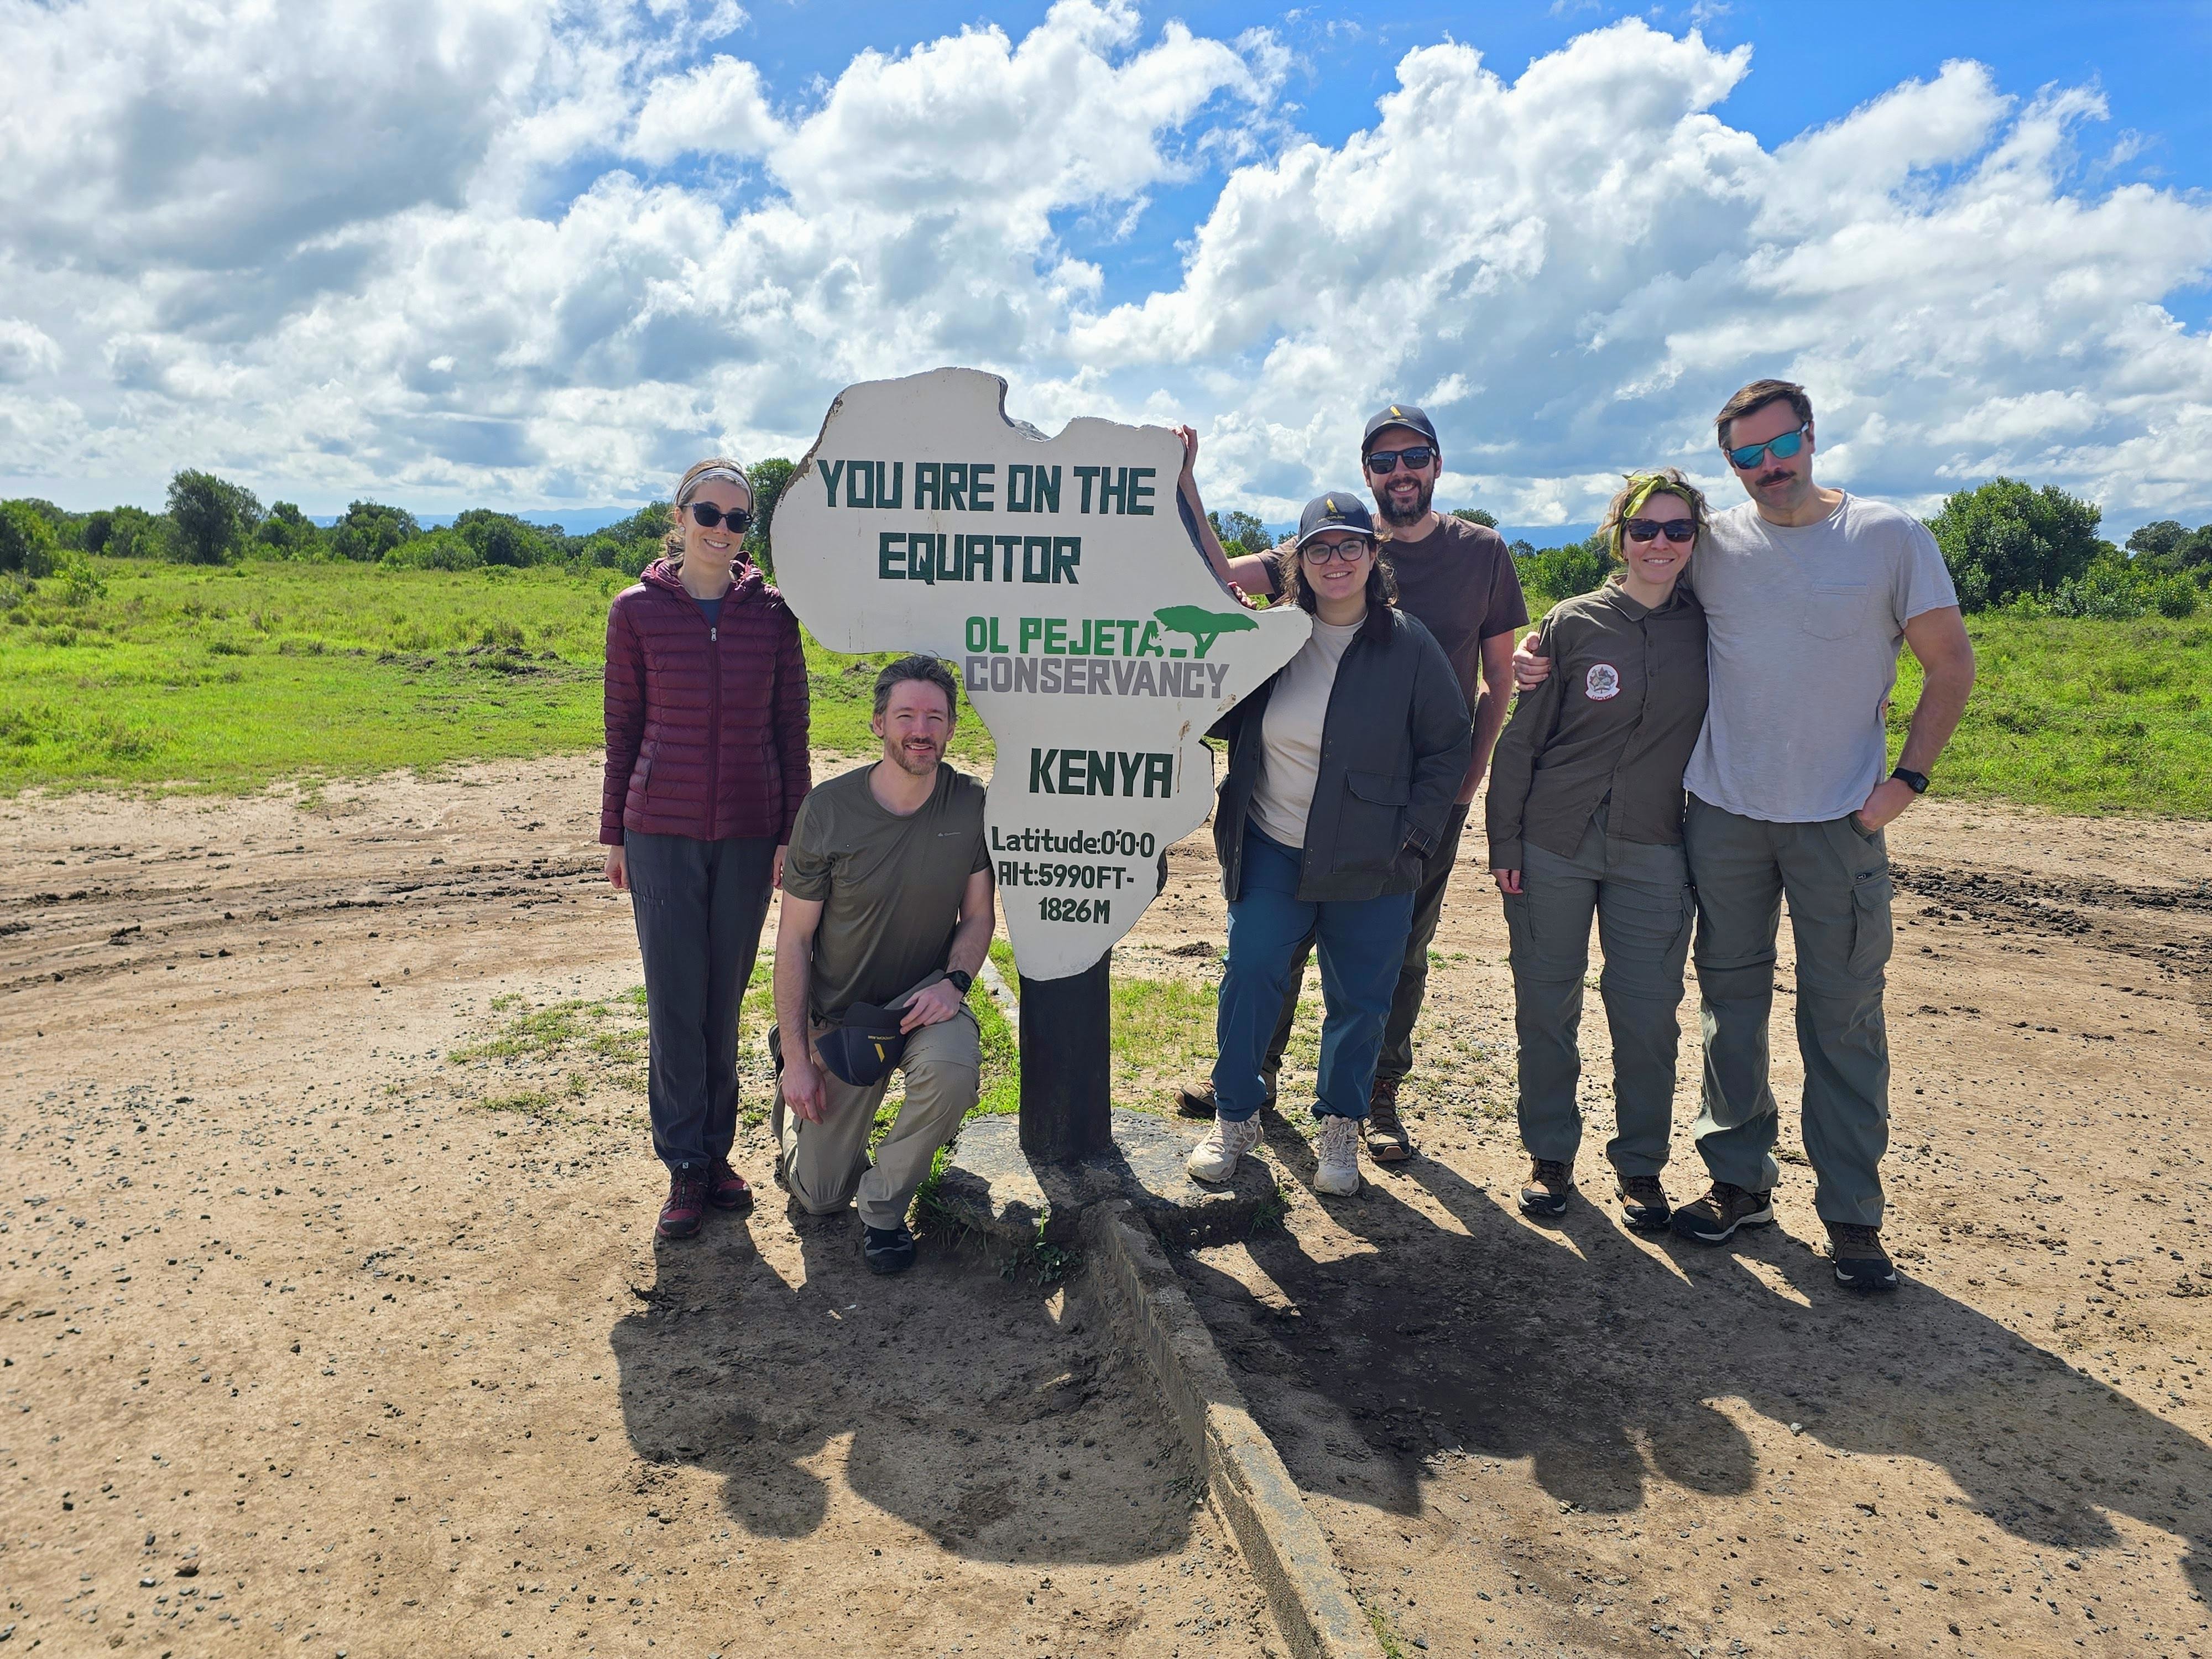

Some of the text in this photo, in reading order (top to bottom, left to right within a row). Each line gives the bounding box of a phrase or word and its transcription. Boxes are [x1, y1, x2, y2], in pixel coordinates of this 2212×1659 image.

[817, 460, 1156, 515] YOU ARE ON THE
[879, 533, 1081, 586] EQUATOR
[966, 617, 1164, 657] OL PEJETA
[966, 656, 1229, 698] CONSERVANCY
[1029, 748, 1173, 798] KENYA
